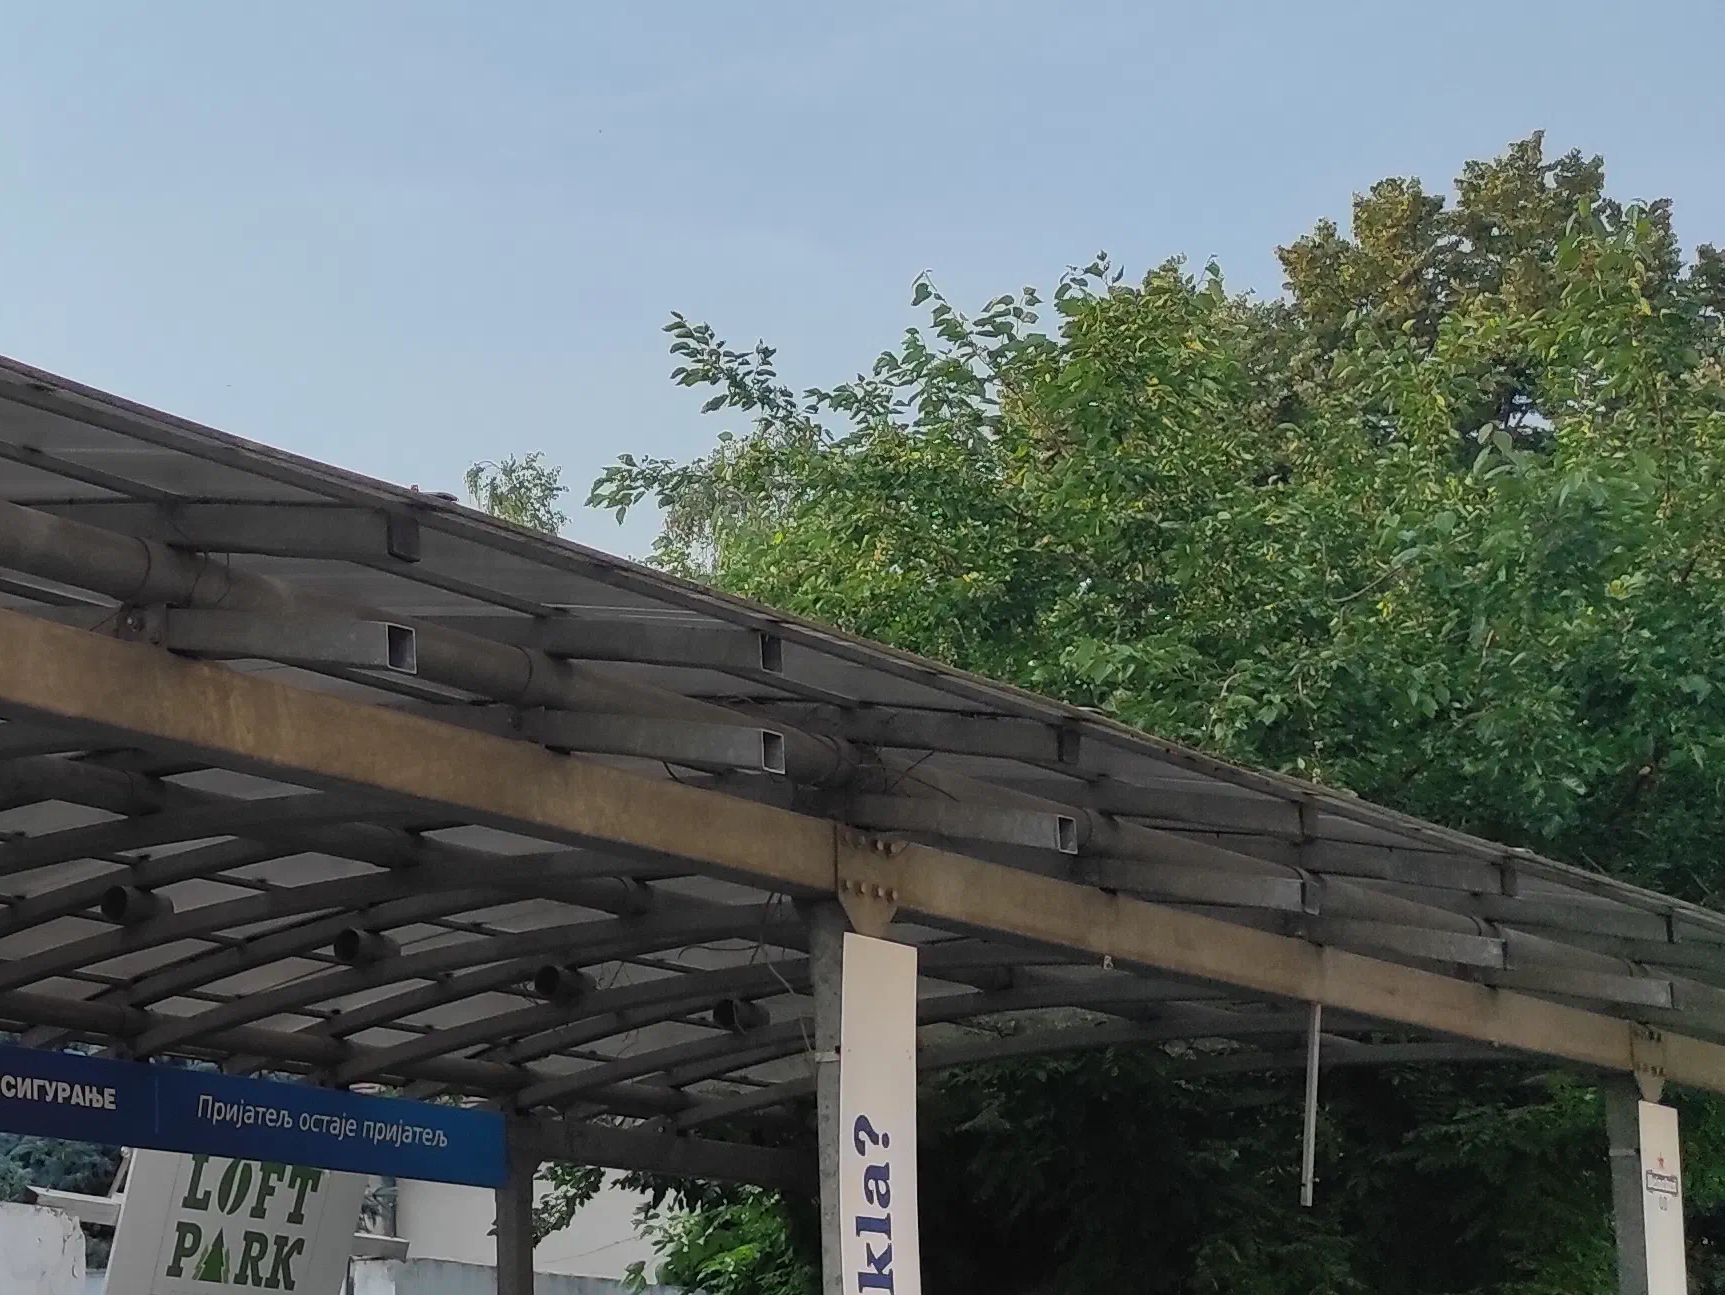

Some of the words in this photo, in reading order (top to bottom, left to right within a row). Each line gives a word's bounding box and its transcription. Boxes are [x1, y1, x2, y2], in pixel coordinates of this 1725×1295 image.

[197, 1095, 293, 1128] Пријатељ
[299, 1112, 357, 1140] остаје
[362, 1119, 448, 1147] пријатељ
[181, 1153, 322, 1225] LOFT
[166, 1221, 306, 1291] PARK
